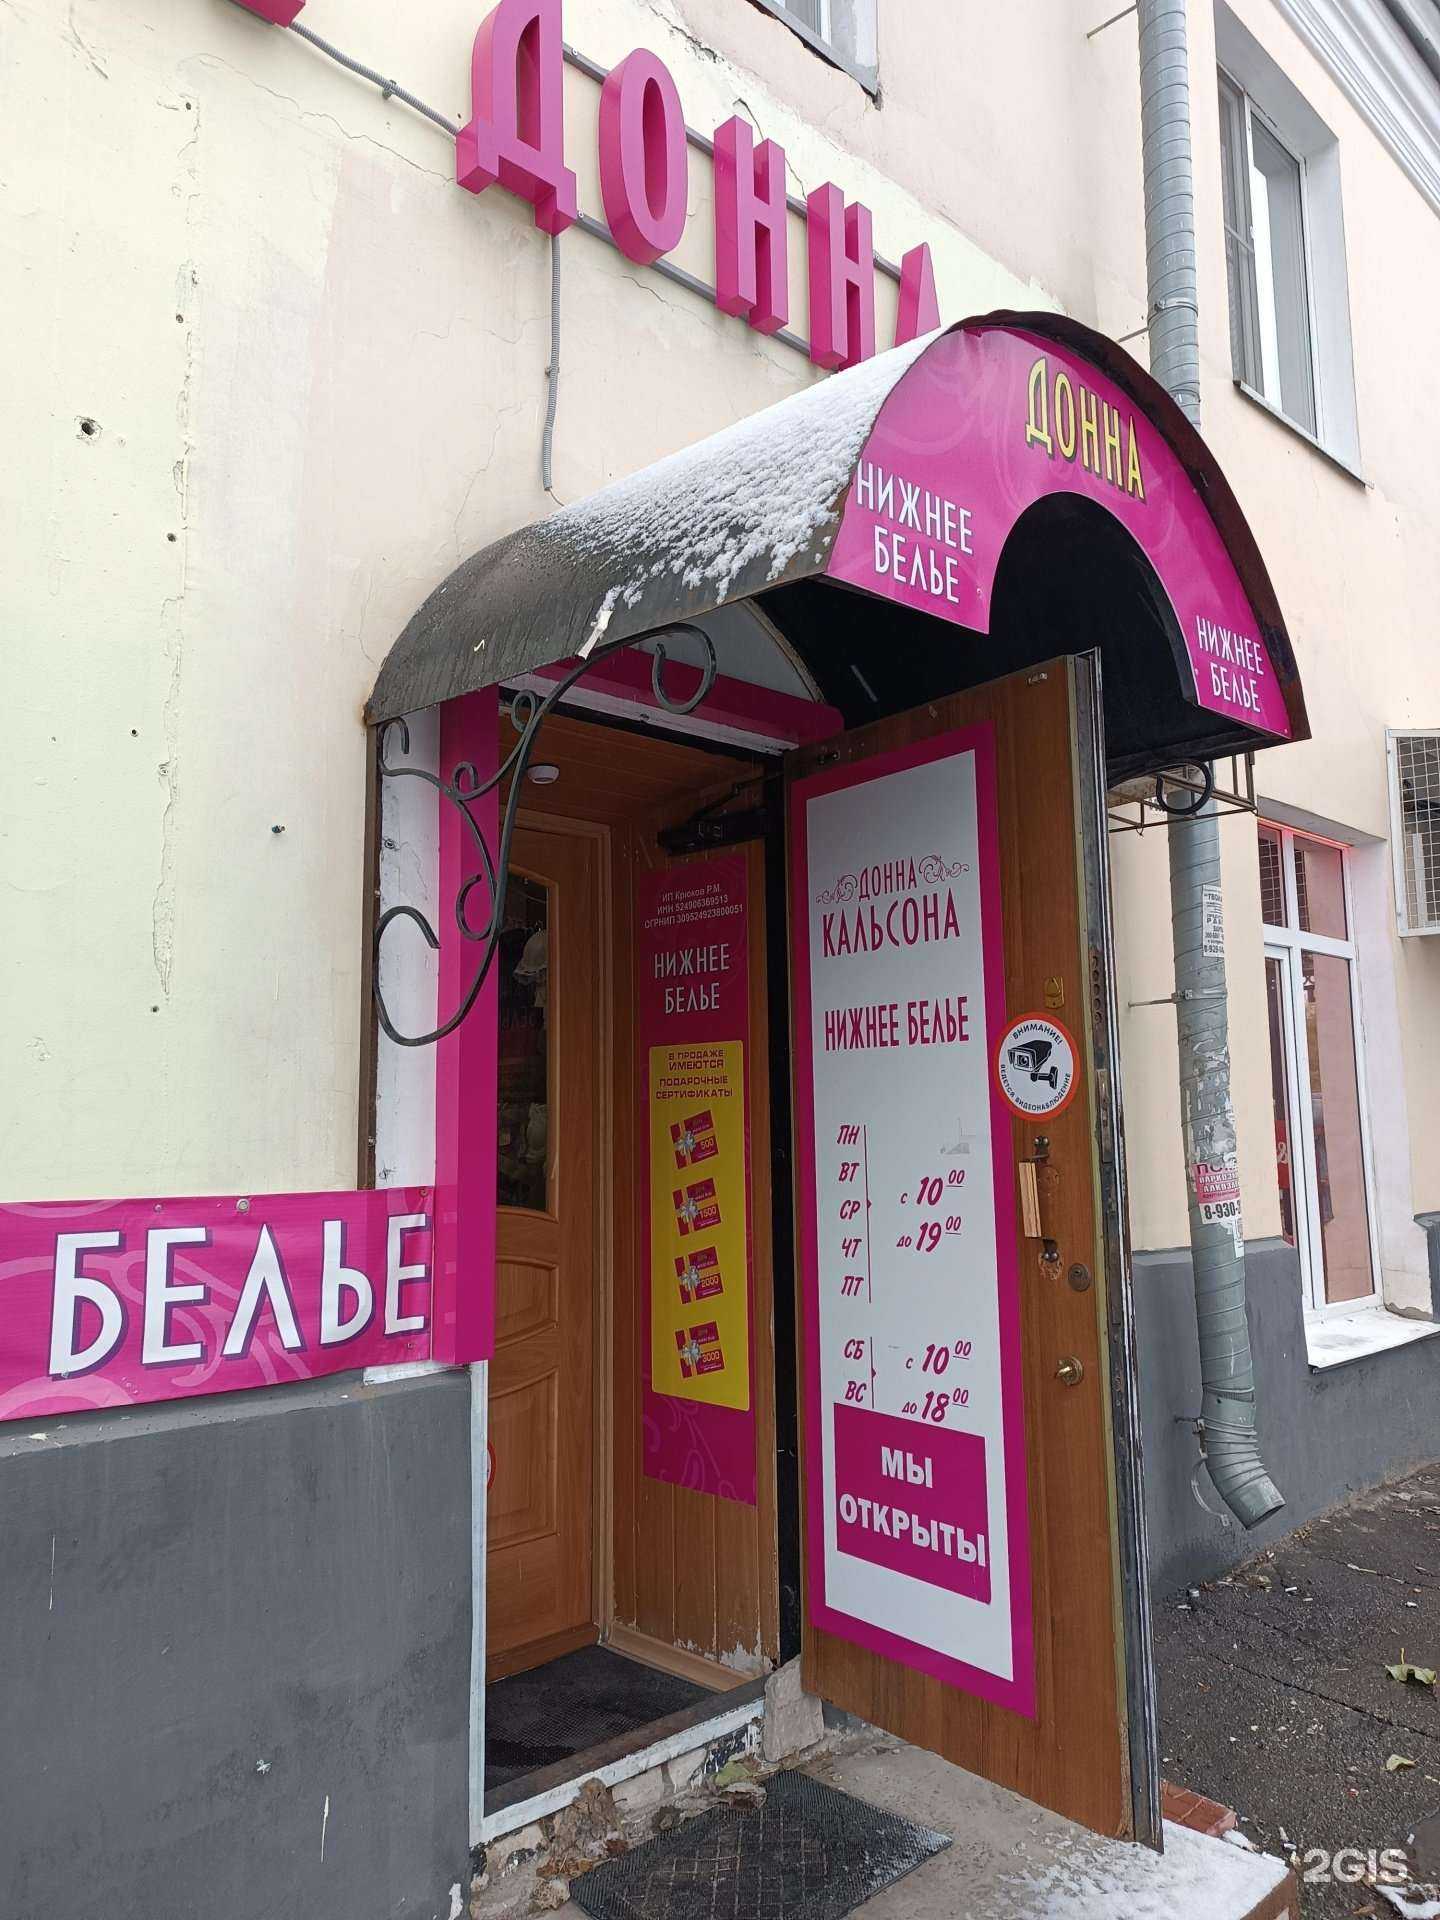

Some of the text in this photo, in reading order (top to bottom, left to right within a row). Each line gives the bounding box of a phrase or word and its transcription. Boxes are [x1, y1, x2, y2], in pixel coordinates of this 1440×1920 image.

[1025, 356, 1147, 505] ДОННА
[856, 459, 974, 555] НИЖНЕЕ
[873, 523, 960, 605] БЕЛЬЕ
[1196, 615, 1264, 676] НИЖНЕЕ
[1211, 662, 1261, 713] БЕЛЬЕ
[858, 856, 918, 902] ДОННА
[662, 891, 673, 903] ИП
[675, 887, 705, 902] Крюков
[644, 914, 676, 929] ОГРНИП
[657, 905, 674, 916] ИНН
[822, 887, 961, 958] КАЛЬСОНА
[655, 943, 730, 978] НИЖНЕЕ
[665, 982, 720, 1014] БЕЛЬЕ
[825, 996, 969, 1051] НИЖНЕЕ БЕЛЬЕ
[1012, 1023, 1063, 1046] ВНИМАНИЕ!
[668, 1059, 724, 1071] ИМЕЮТСЯ
[677, 1049, 724, 1060] ПРОДАЖЕ
[659, 1075, 728, 1087] ПОДАРОЧНЫЕ
[1015, 1072, 1072, 1112] ВИДЕОНАБЛЮДЕНИЕ
[656, 1088, 733, 1100] СЕРТИФИКАТЫ
[700, 1137, 714, 1150] 500
[837, 1125, 859, 1144] ПН
[839, 1162, 859, 1181] ВТ
[699, 1206, 717, 1219] 1500
[840, 1200, 860, 1220] СР
[842, 1238, 862, 1258] ЧТ
[701, 1275, 719, 1288] 2000
[841, 1275, 864, 1297] ПТ
[49, 1213, 428, 1378] БЕЛЬЕ
[702, 1351, 720, 1363] 3000
[844, 1339, 865, 1360] СБ
[845, 1381, 867, 1403] ВС
[881, 1446, 933, 1489] МЫ
[839, 1493, 986, 1568] ОТКРЫТЫ
